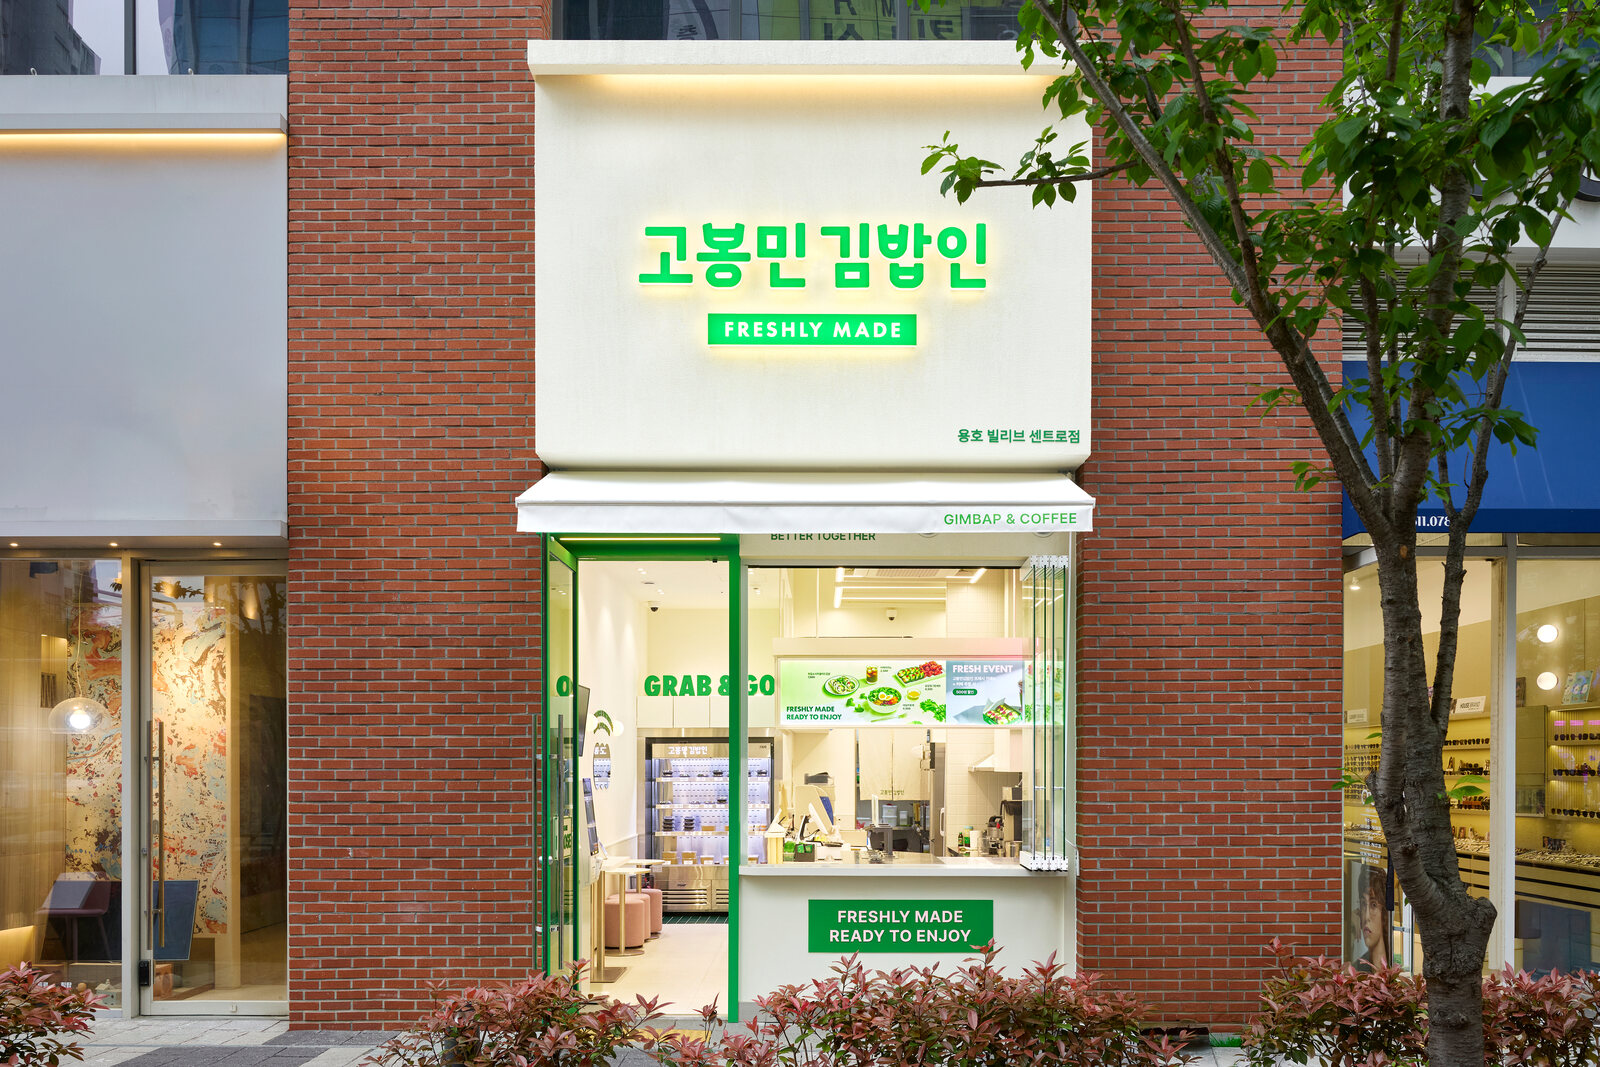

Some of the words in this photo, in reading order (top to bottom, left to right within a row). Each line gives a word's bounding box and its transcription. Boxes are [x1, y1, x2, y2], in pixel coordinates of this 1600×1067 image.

[724, 321, 823, 338] FRESHLY
[832, 321, 902, 338] MADE
[957, 428, 984, 443] 용호
[987, 428, 1026, 443] 빌리브
[1029, 428, 1080, 444] 센트로점
[943, 513, 1002, 526] GIMBAP
[1006, 513, 1016, 525] &
[1019, 512, 1078, 525] COFFEE
[952, 664, 981, 673] FRESH
[983, 664, 1014, 673] EVENT
[644, 674, 712, 697] GRAB
[786, 705, 814, 713] FRESHLY
[814, 705, 835, 713] MADE
[837, 910, 910, 923] FRESHLY
[914, 910, 964, 923] MADE
[829, 929, 885, 943] READY
[889, 929, 912, 943] TO
[916, 929, 972, 943] ENJOY
